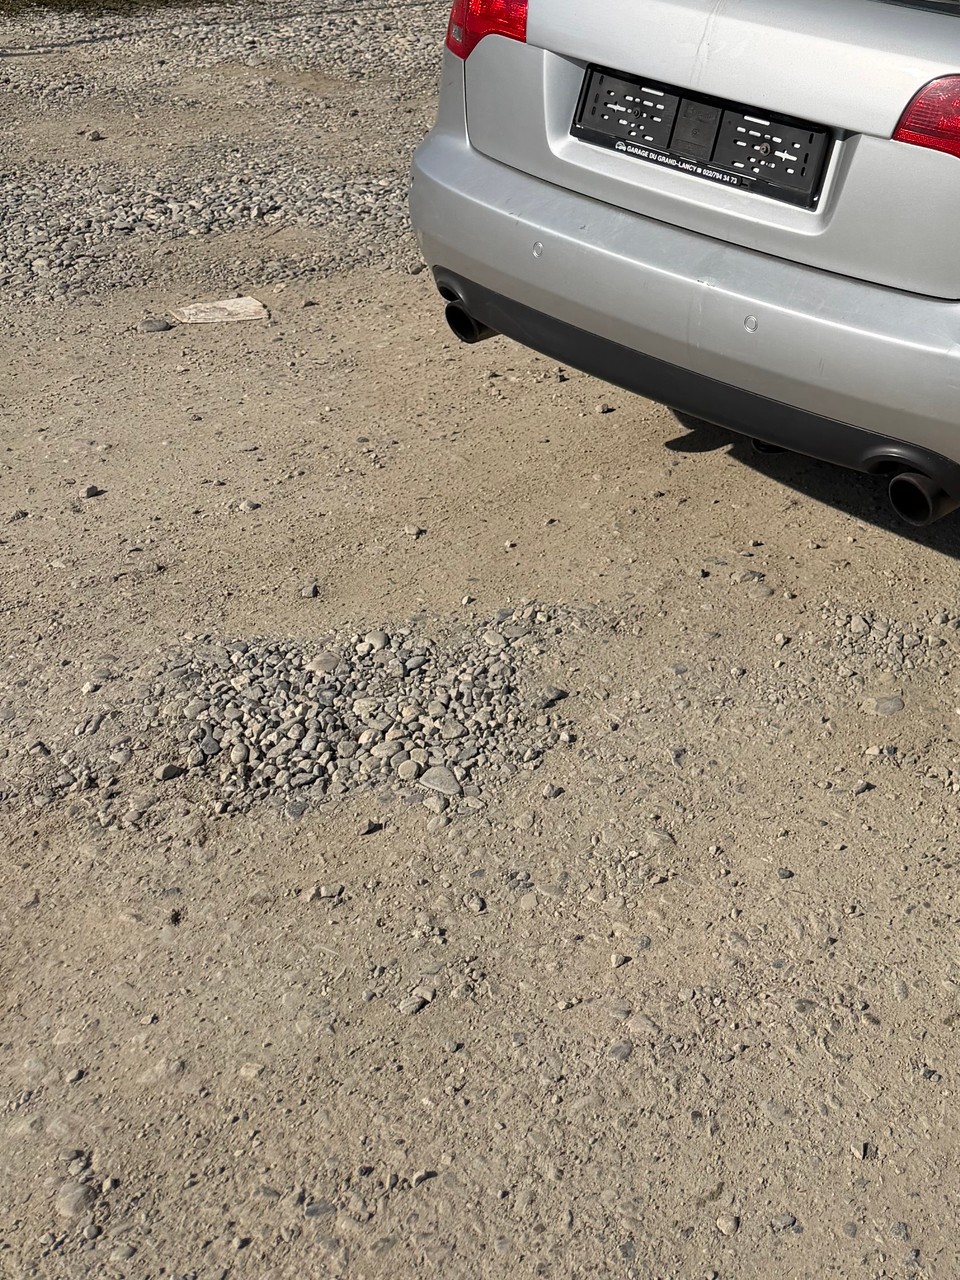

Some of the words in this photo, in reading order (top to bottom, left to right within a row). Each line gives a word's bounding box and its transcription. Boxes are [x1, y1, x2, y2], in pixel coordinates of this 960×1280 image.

[626, 145, 649, 158] GARAGE
[657, 155, 697, 172] GRAND-LANCY
[702, 169, 722, 180] 022/794
[722, 174, 730, 182] 34
[730, 176, 738, 184] 73
